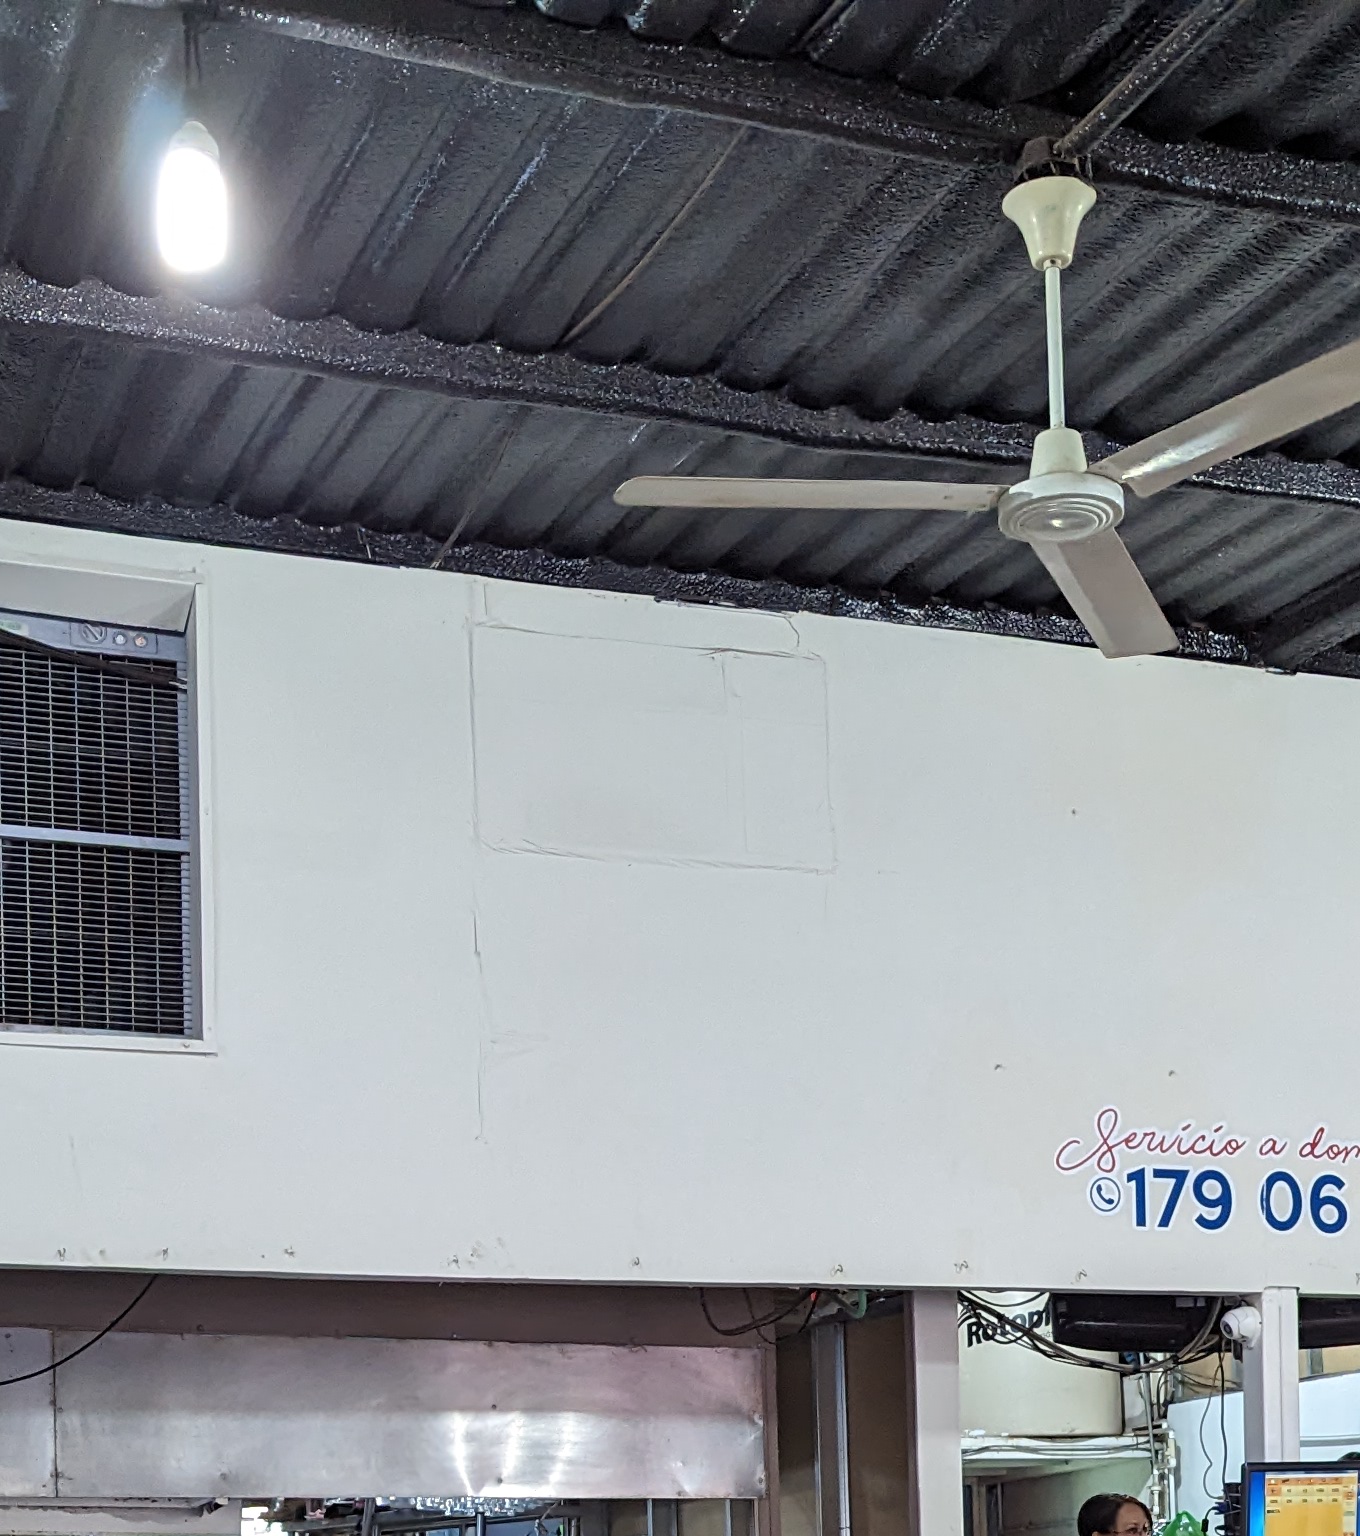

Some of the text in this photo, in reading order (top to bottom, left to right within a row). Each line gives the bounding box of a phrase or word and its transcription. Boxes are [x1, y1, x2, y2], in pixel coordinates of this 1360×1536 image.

[1055, 1108, 1245, 1173] Servicio
[1259, 1138, 1287, 1158] a
[1126, 1167, 1233, 1230] 179
[1260, 1171, 1348, 1234] 06
